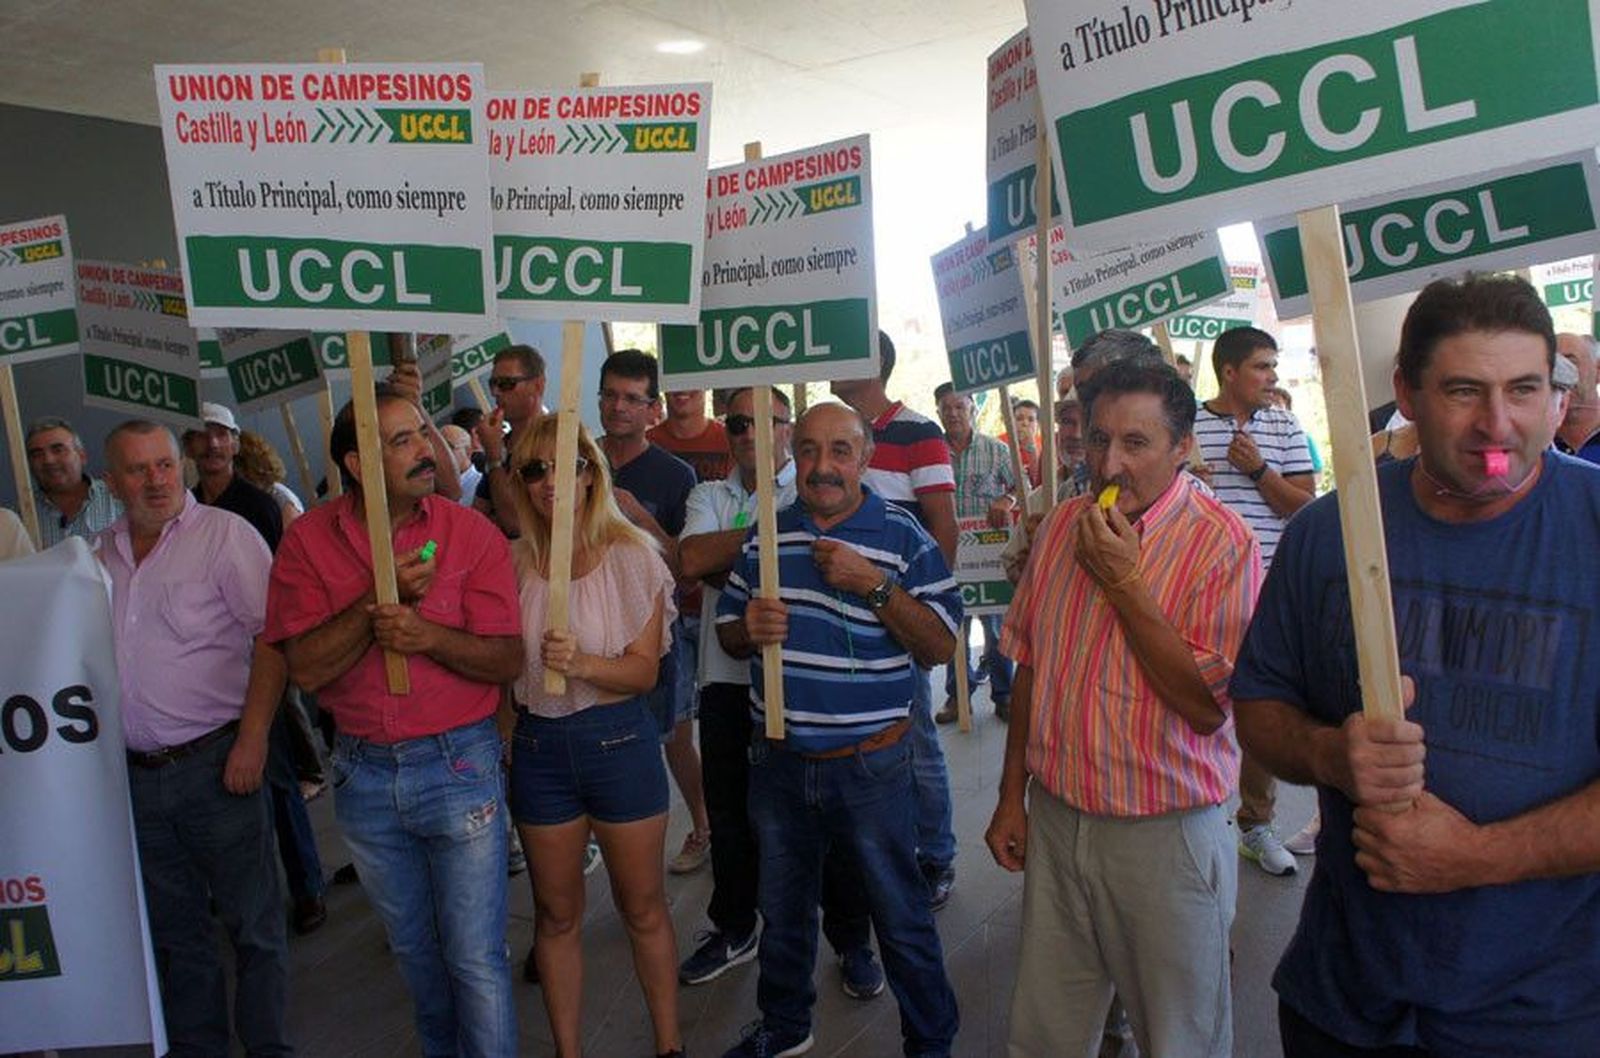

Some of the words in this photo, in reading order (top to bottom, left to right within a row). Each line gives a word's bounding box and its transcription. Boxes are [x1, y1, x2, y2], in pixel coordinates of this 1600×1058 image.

[1060, 41, 1075, 71] a
[1075, 5, 1151, 64] Título
[169, 74, 253, 102] UNION
[262, 75, 294, 101] DE
[302, 74, 472, 102] CAMPESINOS
[486, 97, 517, 121] ON
[523, 96, 551, 119] DE
[557, 92, 700, 118] CAMPESINOS
[176, 111, 243, 144] Castilla
[247, 119, 258, 151] y
[264, 112, 307, 144] León
[400, 113, 465, 141] UCCL
[1129, 36, 1477, 194] UCCL
[505, 134, 515, 161] y
[519, 128, 556, 156] León
[634, 126, 690, 151] UCCL
[717, 170, 740, 195] DE
[744, 145, 862, 194] CAMPESINOS
[192, 189, 203, 208] a
[204, 181, 256, 209] Título
[259, 181, 343, 216] Principal,
[346, 188, 394, 210] como
[396, 184, 466, 217] siempre
[506, 187, 576, 217] Principal,
[579, 192, 620, 211] como
[623, 187, 684, 217] siempre
[809, 181, 855, 212] UCCL
[707, 214, 715, 239] y
[718, 204, 747, 230] León
[237, 248, 432, 305] UCCL
[712, 257, 770, 287] Principal,
[771, 254, 804, 278] como
[806, 244, 857, 274] siempre
[1090, 274, 1198, 334] UCCL
[695, 307, 832, 368] UCCL
[238, 349, 302, 397] UCCL
[963, 340, 1020, 385] UCCL
[104, 363, 180, 408] UCCL
